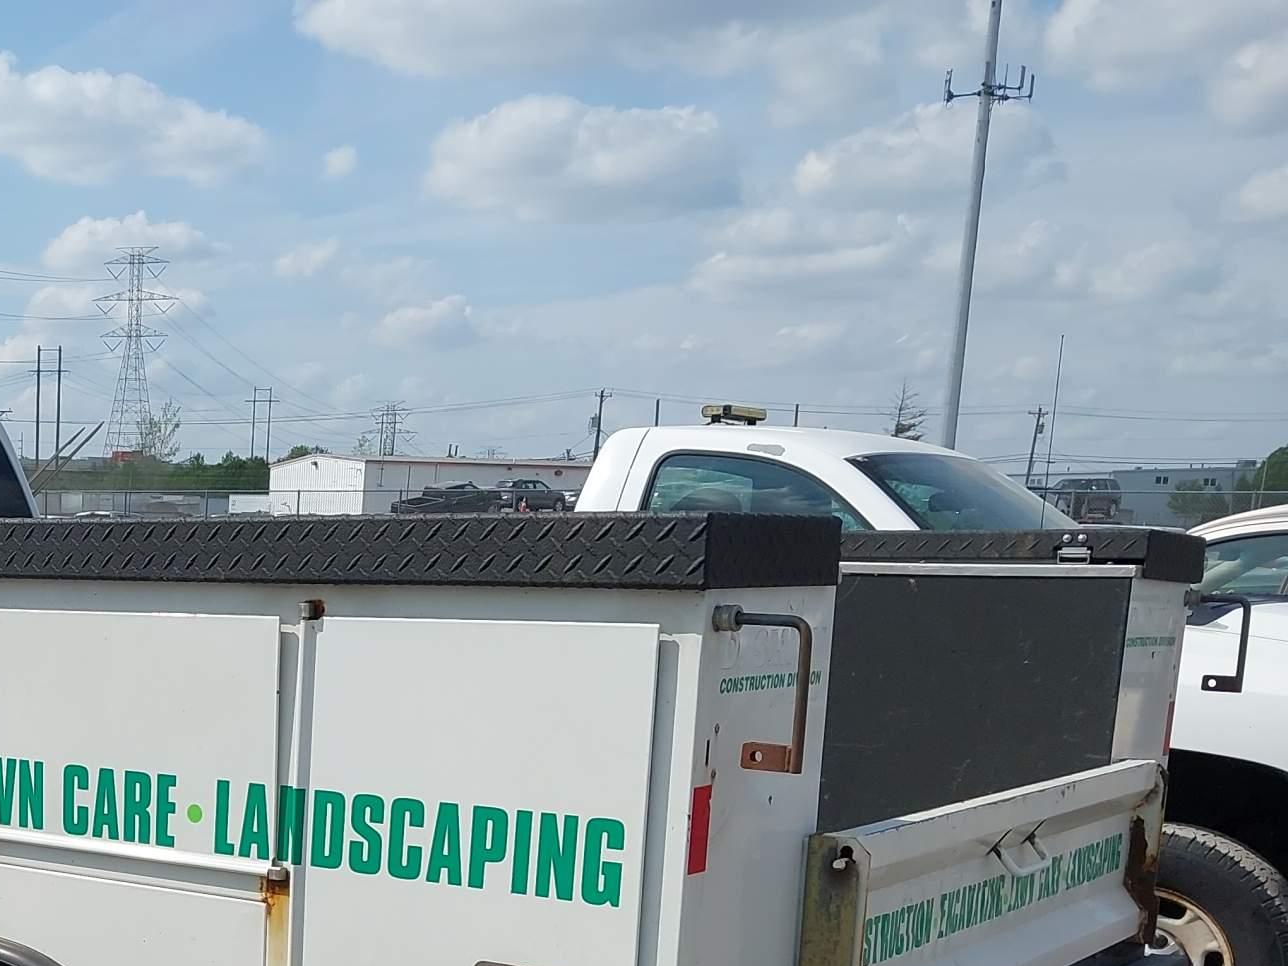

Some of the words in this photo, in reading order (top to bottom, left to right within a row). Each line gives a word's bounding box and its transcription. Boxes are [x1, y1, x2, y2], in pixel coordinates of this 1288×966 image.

[719, 672, 786, 695] CONSTRUCTION
[61, 762, 179, 849] CARE
[212, 777, 627, 909] LANDSCAPING
